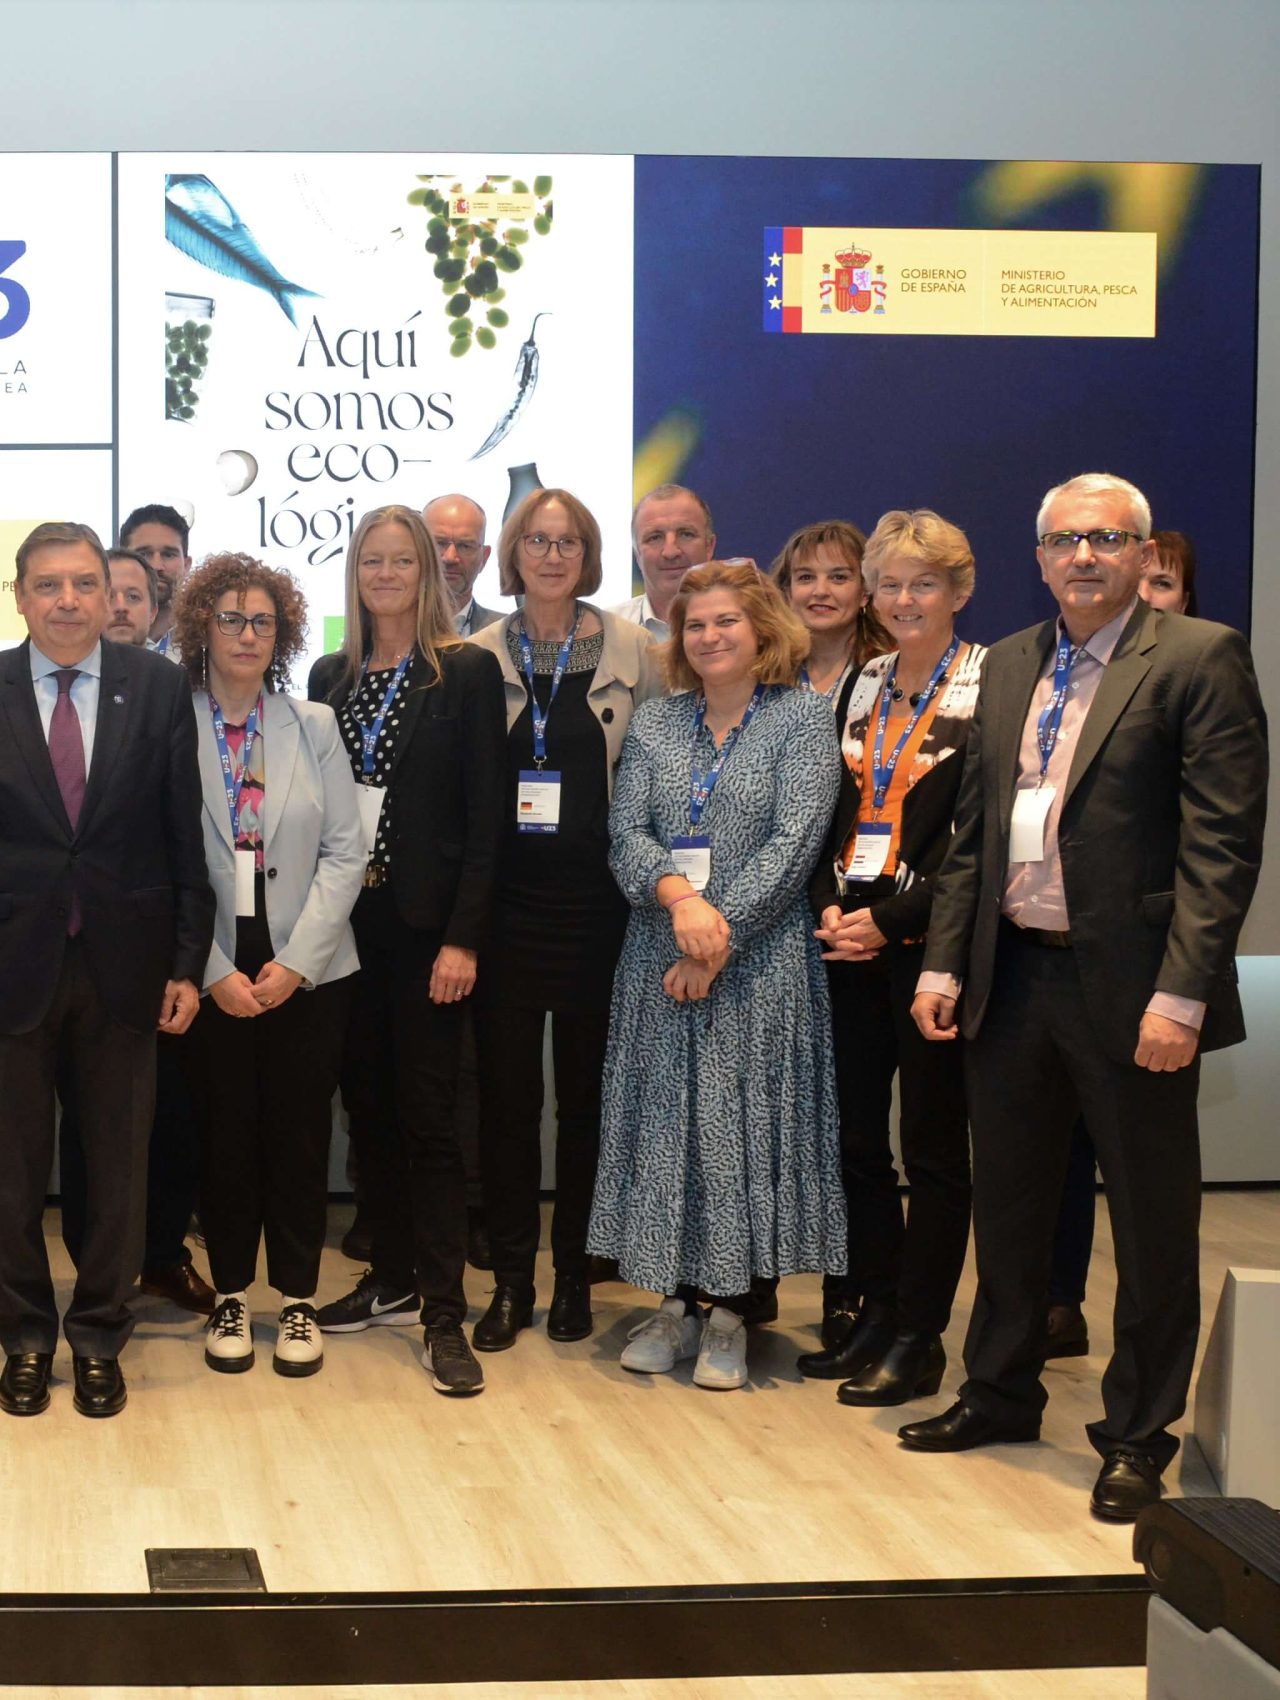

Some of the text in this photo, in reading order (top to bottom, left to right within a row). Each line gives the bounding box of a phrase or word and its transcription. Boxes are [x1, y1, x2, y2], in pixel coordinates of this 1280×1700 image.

[900, 268, 967, 280] GOBIERNO
[1000, 269, 1066, 281] MINISTERIO
[900, 279, 967, 294] DE ESPAÑA
[1000, 284, 1138, 297] DE AGRICULTURA, PESCA
[1000, 295, 1097, 309] Y ALIMENTACIÓN
[297, 310, 422, 379] Aquí
[265, 391, 454, 431] somos
[257, 490, 354, 566] lógi
